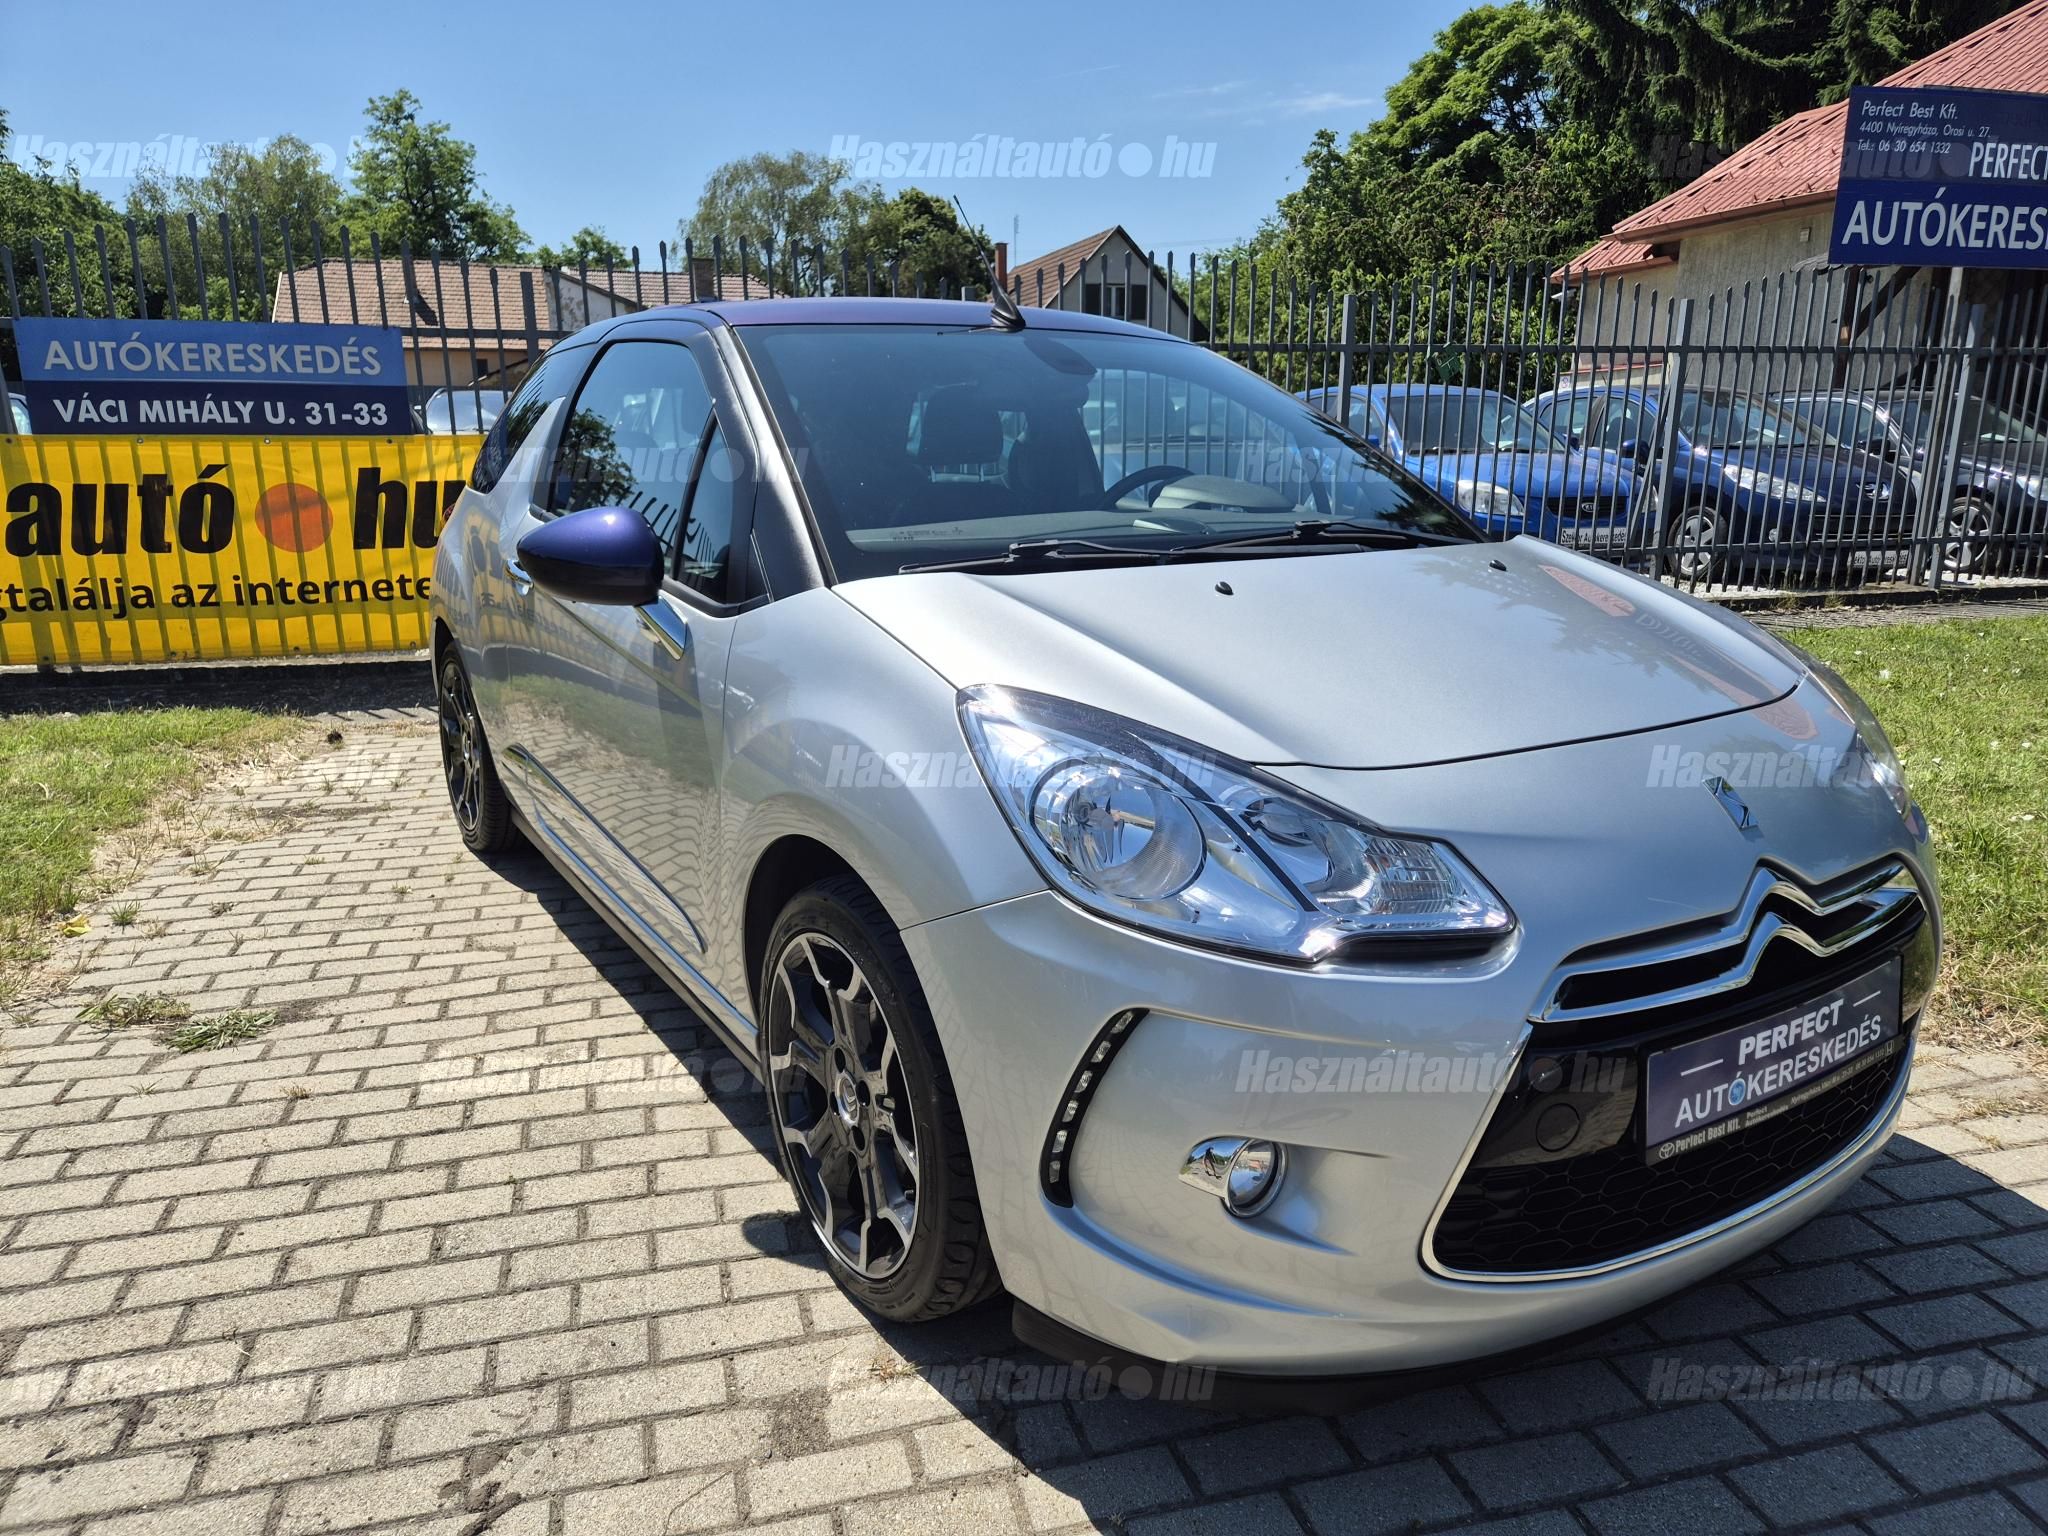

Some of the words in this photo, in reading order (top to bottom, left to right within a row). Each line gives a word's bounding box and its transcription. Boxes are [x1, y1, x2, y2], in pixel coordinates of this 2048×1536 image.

[1859, 121, 1883, 133] 4400
[1861, 100, 1904, 117] Perfect
[1909, 102, 1934, 119] Best
[1939, 103, 1958, 120] Kft.
[1878, 140, 1890, 152] 06
[1894, 140, 1906, 152] 30
[1909, 141, 1926, 153] 654
[1930, 141, 1952, 154] 1332
[1841, 187, 2048, 250] AUTÓKERES
[44, 331, 382, 376] AUTÓKERESKEDÉS
[53, 392, 127, 423] VÁCI
[139, 393, 254, 424] MIHÁLY
[263, 401, 296, 425] U.
[304, 401, 389, 426] 31-33
[4, 464, 236, 557] autó
[170, 584, 221, 608] az
[1738, 998, 1845, 1066] PERFECT
[1673, 1013, 1882, 1130] AUTÓKERESKEDÉS
[1675, 1129, 1706, 1153] Perfect
[1707, 1122, 1726, 1141] Best
